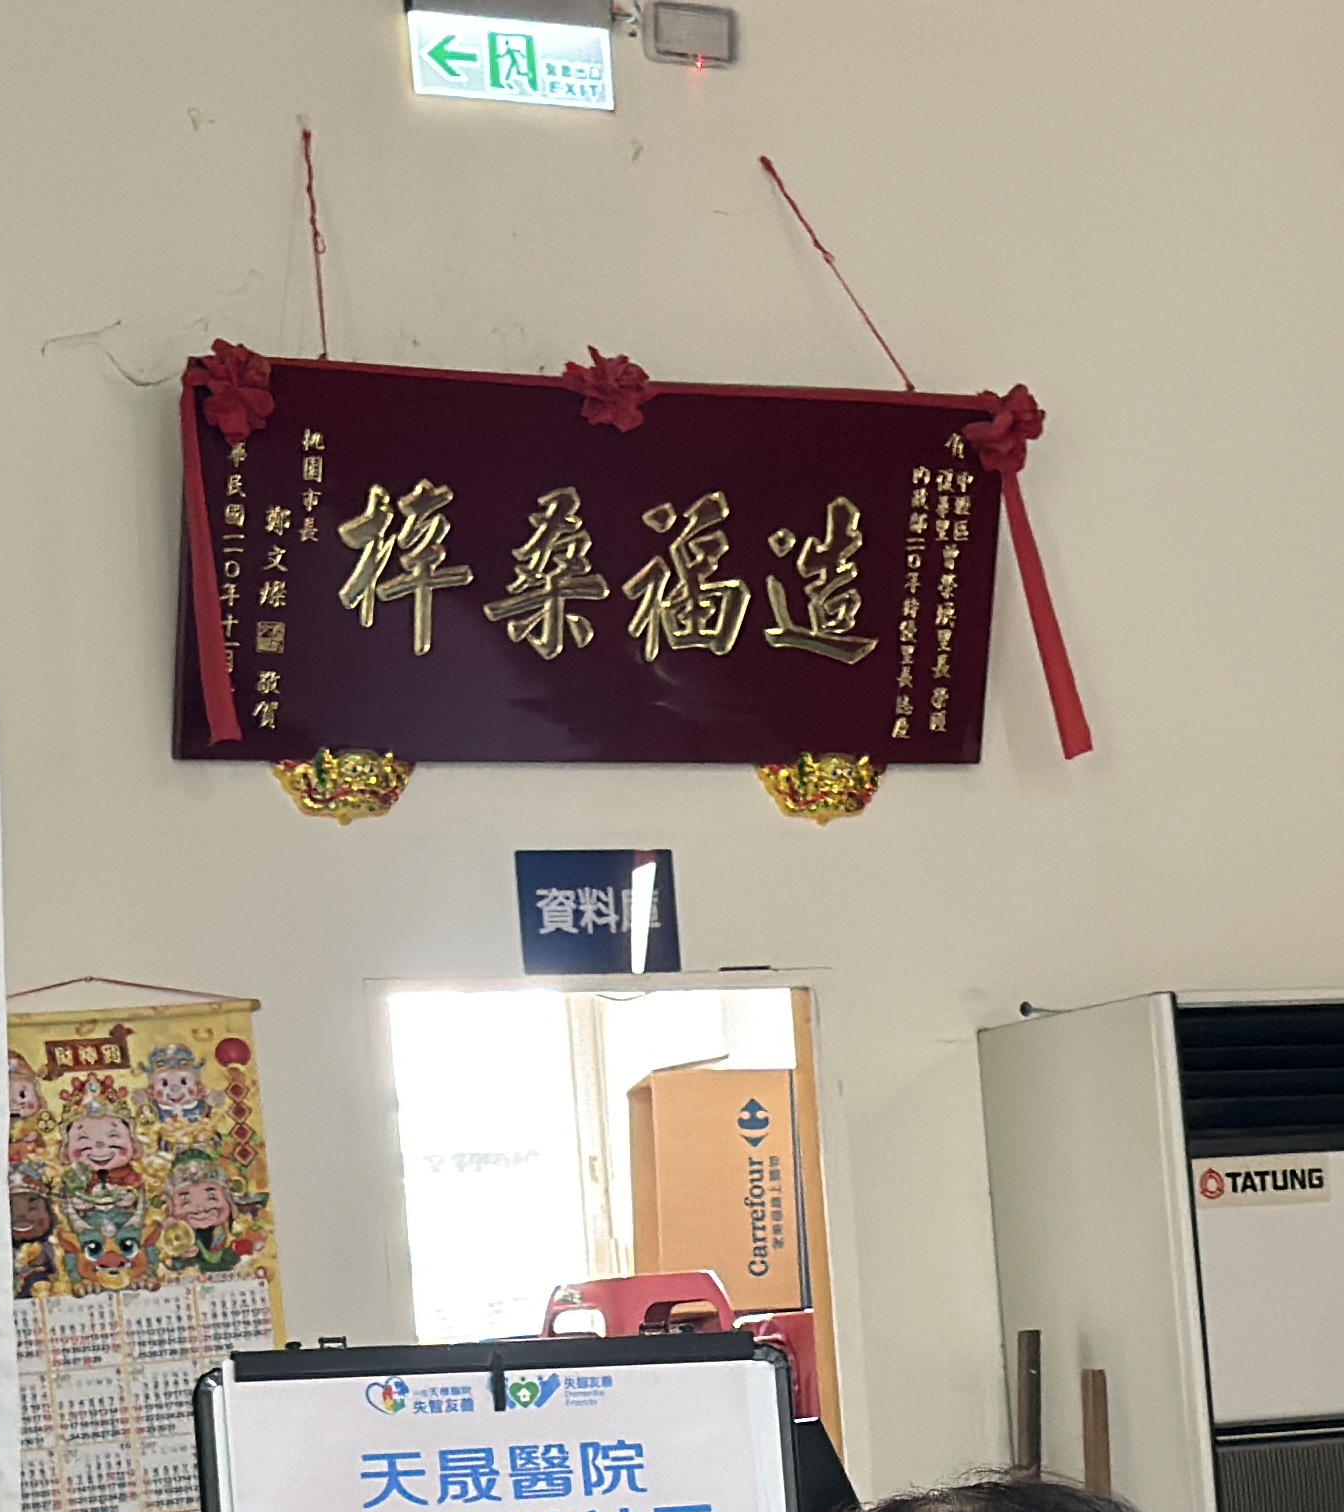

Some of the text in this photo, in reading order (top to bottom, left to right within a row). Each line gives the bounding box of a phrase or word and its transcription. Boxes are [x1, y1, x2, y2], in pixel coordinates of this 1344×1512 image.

[549, 81, 599, 97] EXIT
[1225, 1168, 1324, 1193] TATUNG
[744, 1157, 769, 1277] Carrefour
[413, 1397, 474, 1415] 失智友善
[360, 1439, 649, 1510] 天晟醫院
